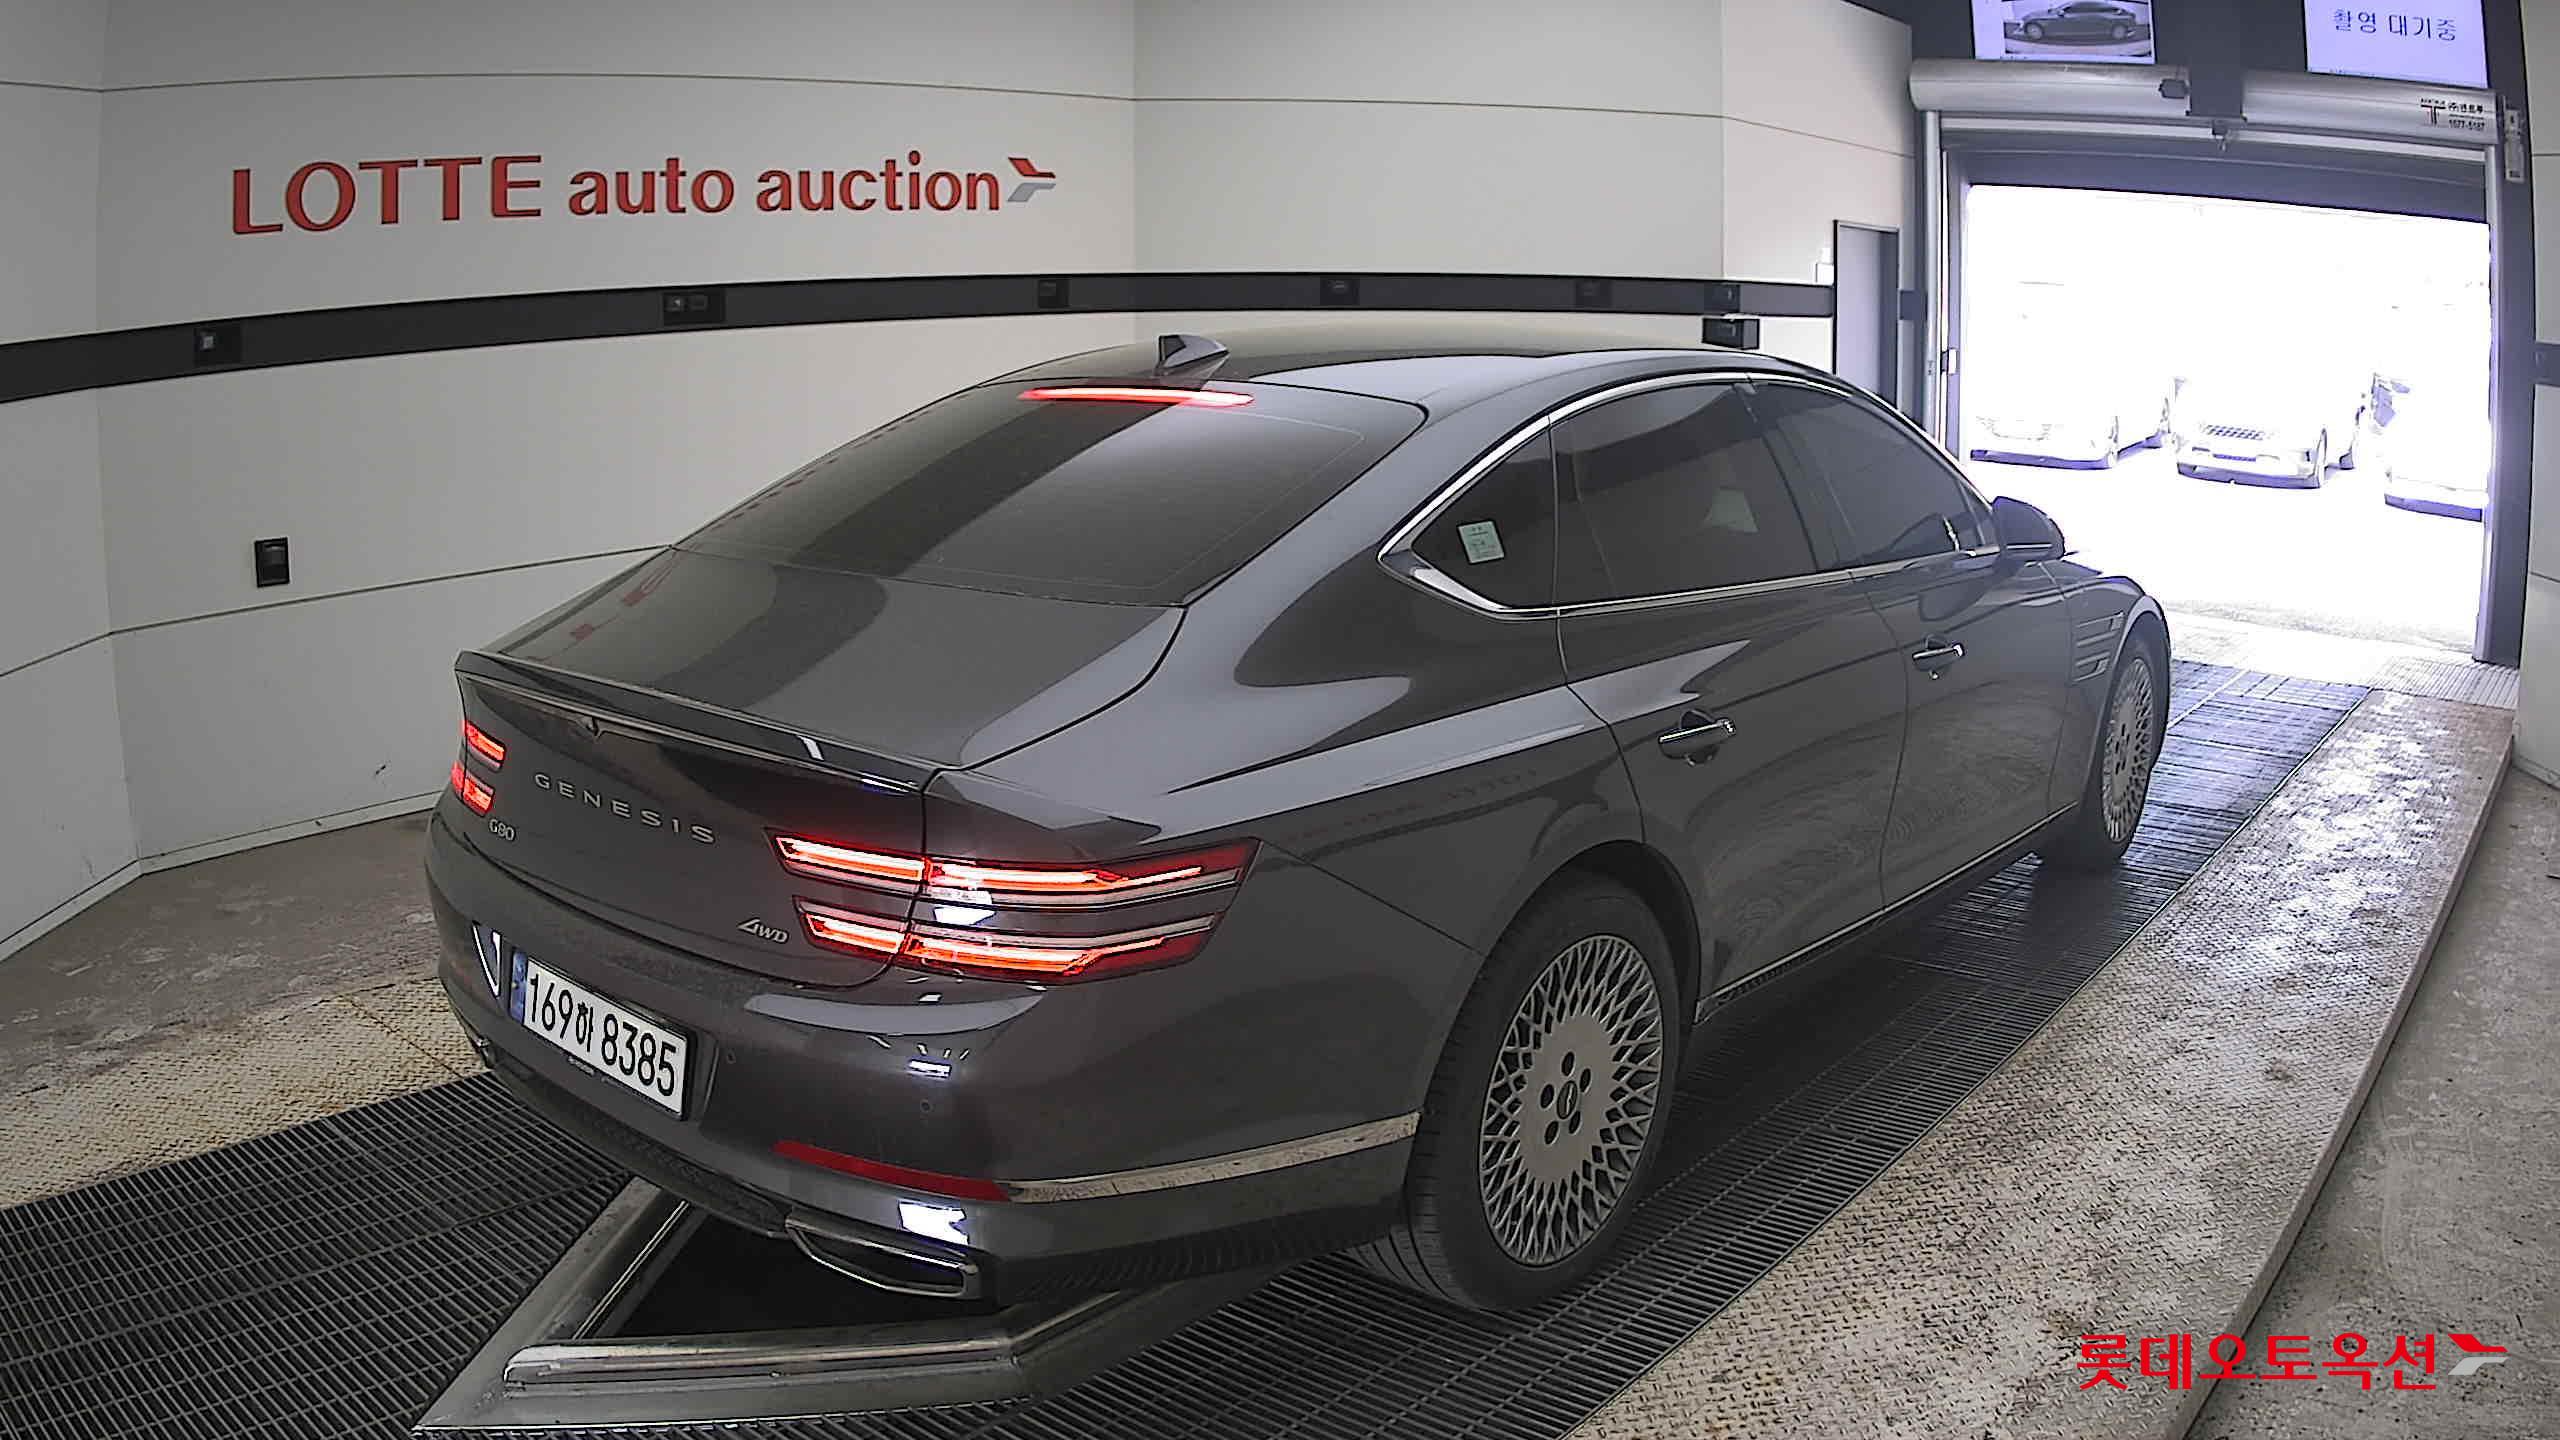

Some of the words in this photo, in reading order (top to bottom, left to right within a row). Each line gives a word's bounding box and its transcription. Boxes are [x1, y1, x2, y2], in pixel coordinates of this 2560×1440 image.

[2333, 8, 2377, 35] 촬영
[2388, 14, 2457, 42] 대기중
[233, 155, 542, 236] LOTTE
[568, 157, 736, 215] auto
[756, 150, 1002, 213] auction
[489, 818, 516, 841] G80
[534, 773, 717, 845] GENESIS
[736, 918, 789, 943] 4WD
[528, 973, 595, 1053] 169하
[600, 1012, 678, 1097] 8385
